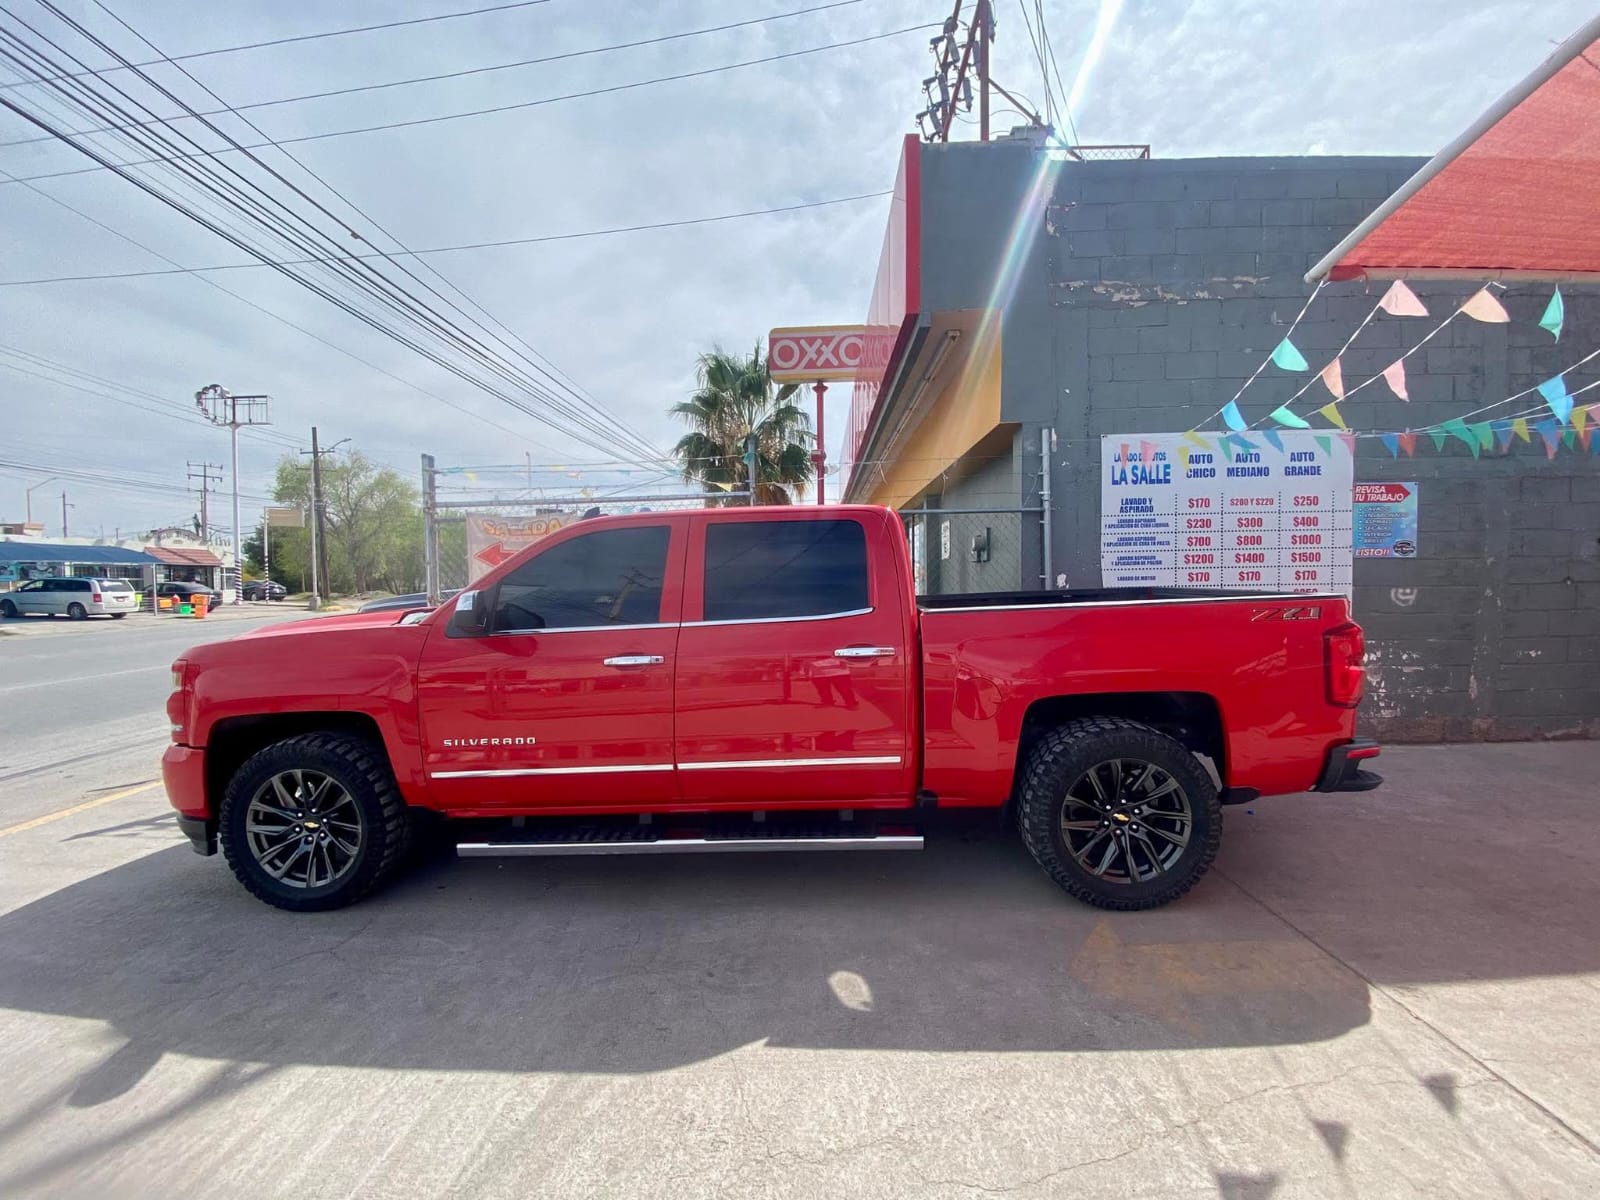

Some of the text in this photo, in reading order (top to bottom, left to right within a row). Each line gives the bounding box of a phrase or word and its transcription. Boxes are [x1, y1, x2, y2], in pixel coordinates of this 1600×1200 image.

[773, 332, 866, 369] OXXO
[1188, 454, 1212, 464] AUTO
[1235, 452, 1260, 463] AUTO
[1290, 452, 1314, 462] AUTO
[1112, 464, 1171, 485] LA SALLE
[1186, 468, 1216, 478] CHICO
[1227, 466, 1270, 478] MEDIANO
[1284, 466, 1322, 476] GRANDE
[1294, 496, 1318, 506] $250
[1367, 493, 1404, 502] TRABAJO
[1188, 498, 1210, 508] $170
[1186, 518, 1212, 529] $230
[1237, 518, 1263, 528] $300
[1293, 516, 1318, 527] $400
[1187, 536, 1211, 547] $700
[1237, 535, 1262, 546] $800
[1291, 534, 1321, 545] $1000
[1184, 554, 1214, 564] $1200
[1235, 553, 1264, 563] $1400
[1291, 552, 1321, 562] $1500
[1188, 572, 1210, 582] $170
[1239, 571, 1260, 581] $170
[1295, 570, 1316, 580] $170
[443, 737, 536, 746] SILVERADO
